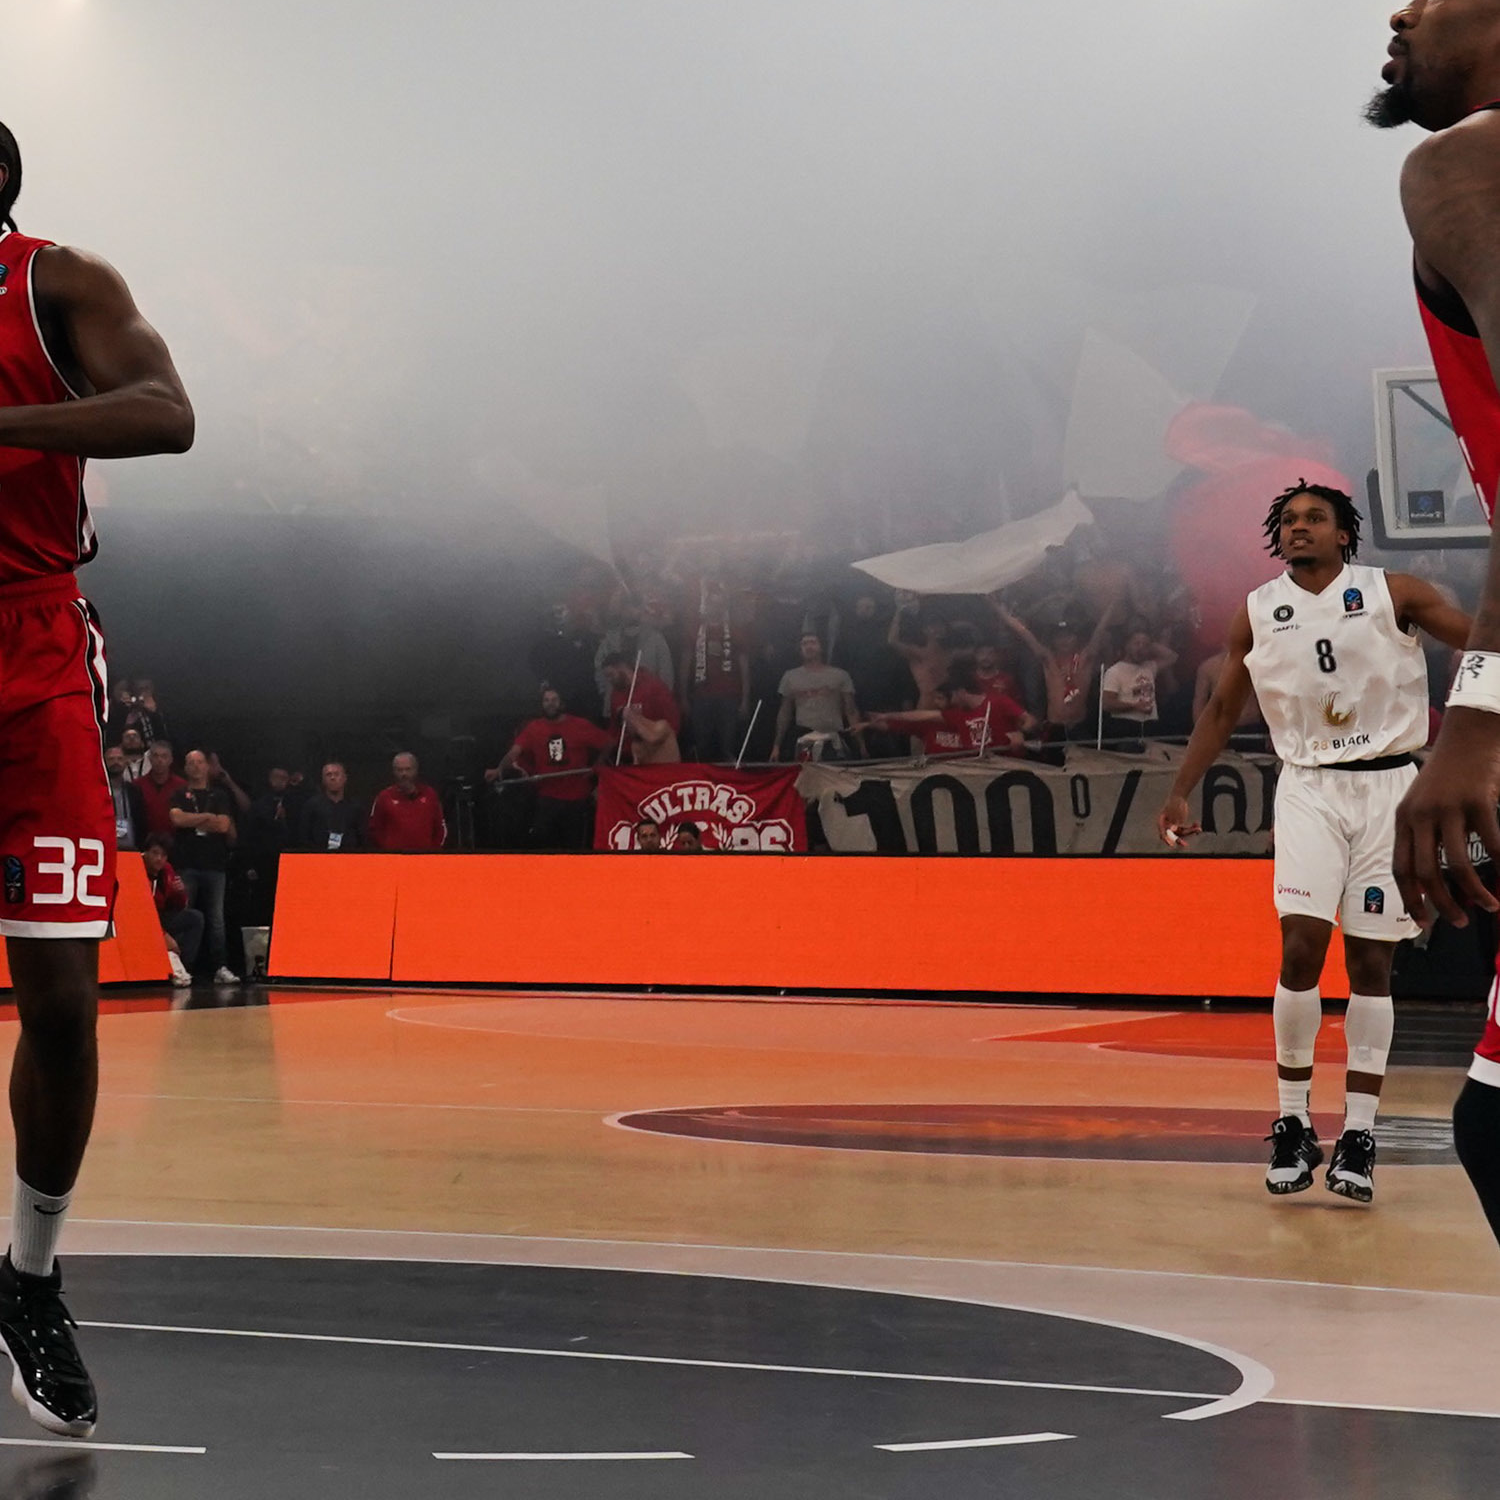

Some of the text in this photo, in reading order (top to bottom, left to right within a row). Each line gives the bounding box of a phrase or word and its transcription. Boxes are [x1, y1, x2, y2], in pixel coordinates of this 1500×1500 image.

[1315, 638, 1337, 673] 8
[1332, 734, 1371, 749] BLACK
[643, 786, 750, 824] ULTRAS
[32, 835, 108, 908] 32
